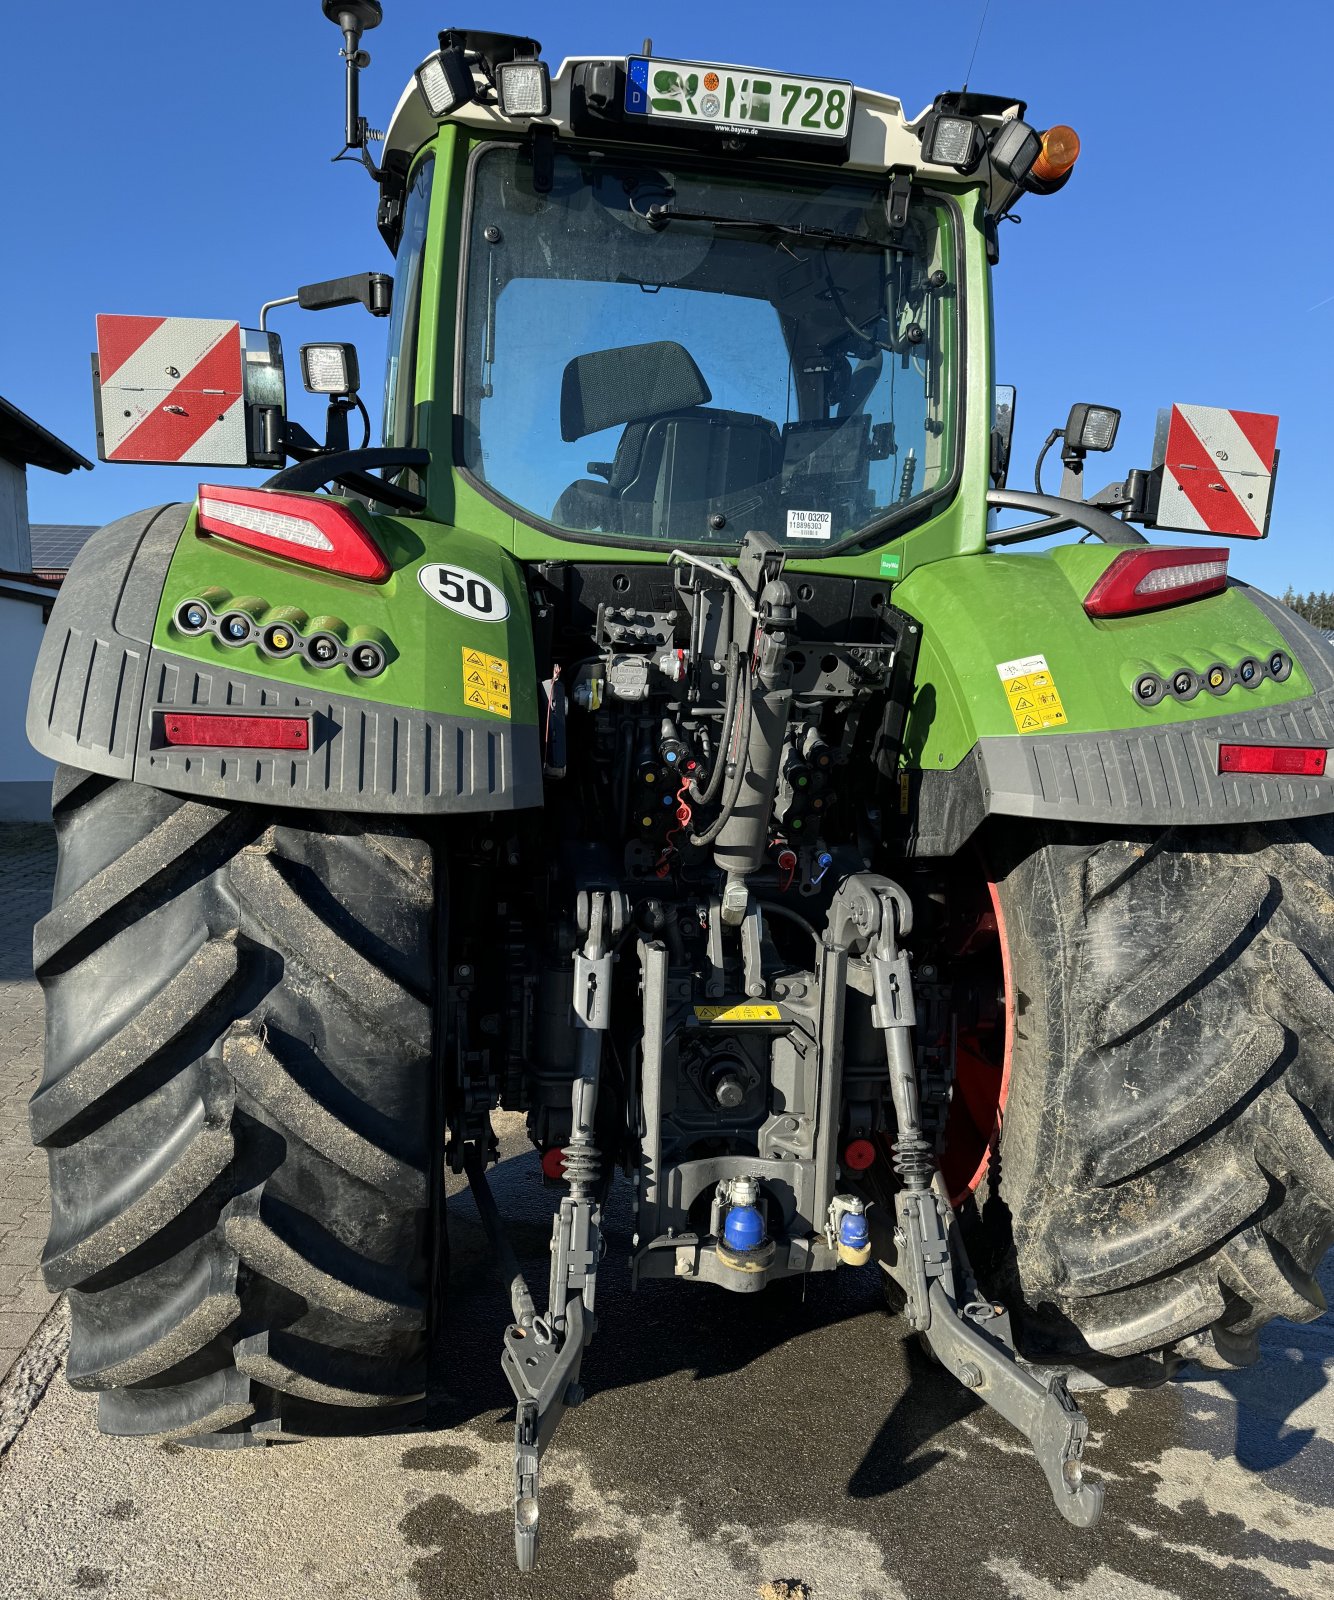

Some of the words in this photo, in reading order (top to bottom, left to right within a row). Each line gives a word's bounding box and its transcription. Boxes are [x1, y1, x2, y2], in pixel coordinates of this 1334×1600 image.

[632, 91, 641, 104] D
[780, 83, 845, 130] 728
[714, 125, 759, 134] www.baywa.de
[438, 567, 493, 614] 50
